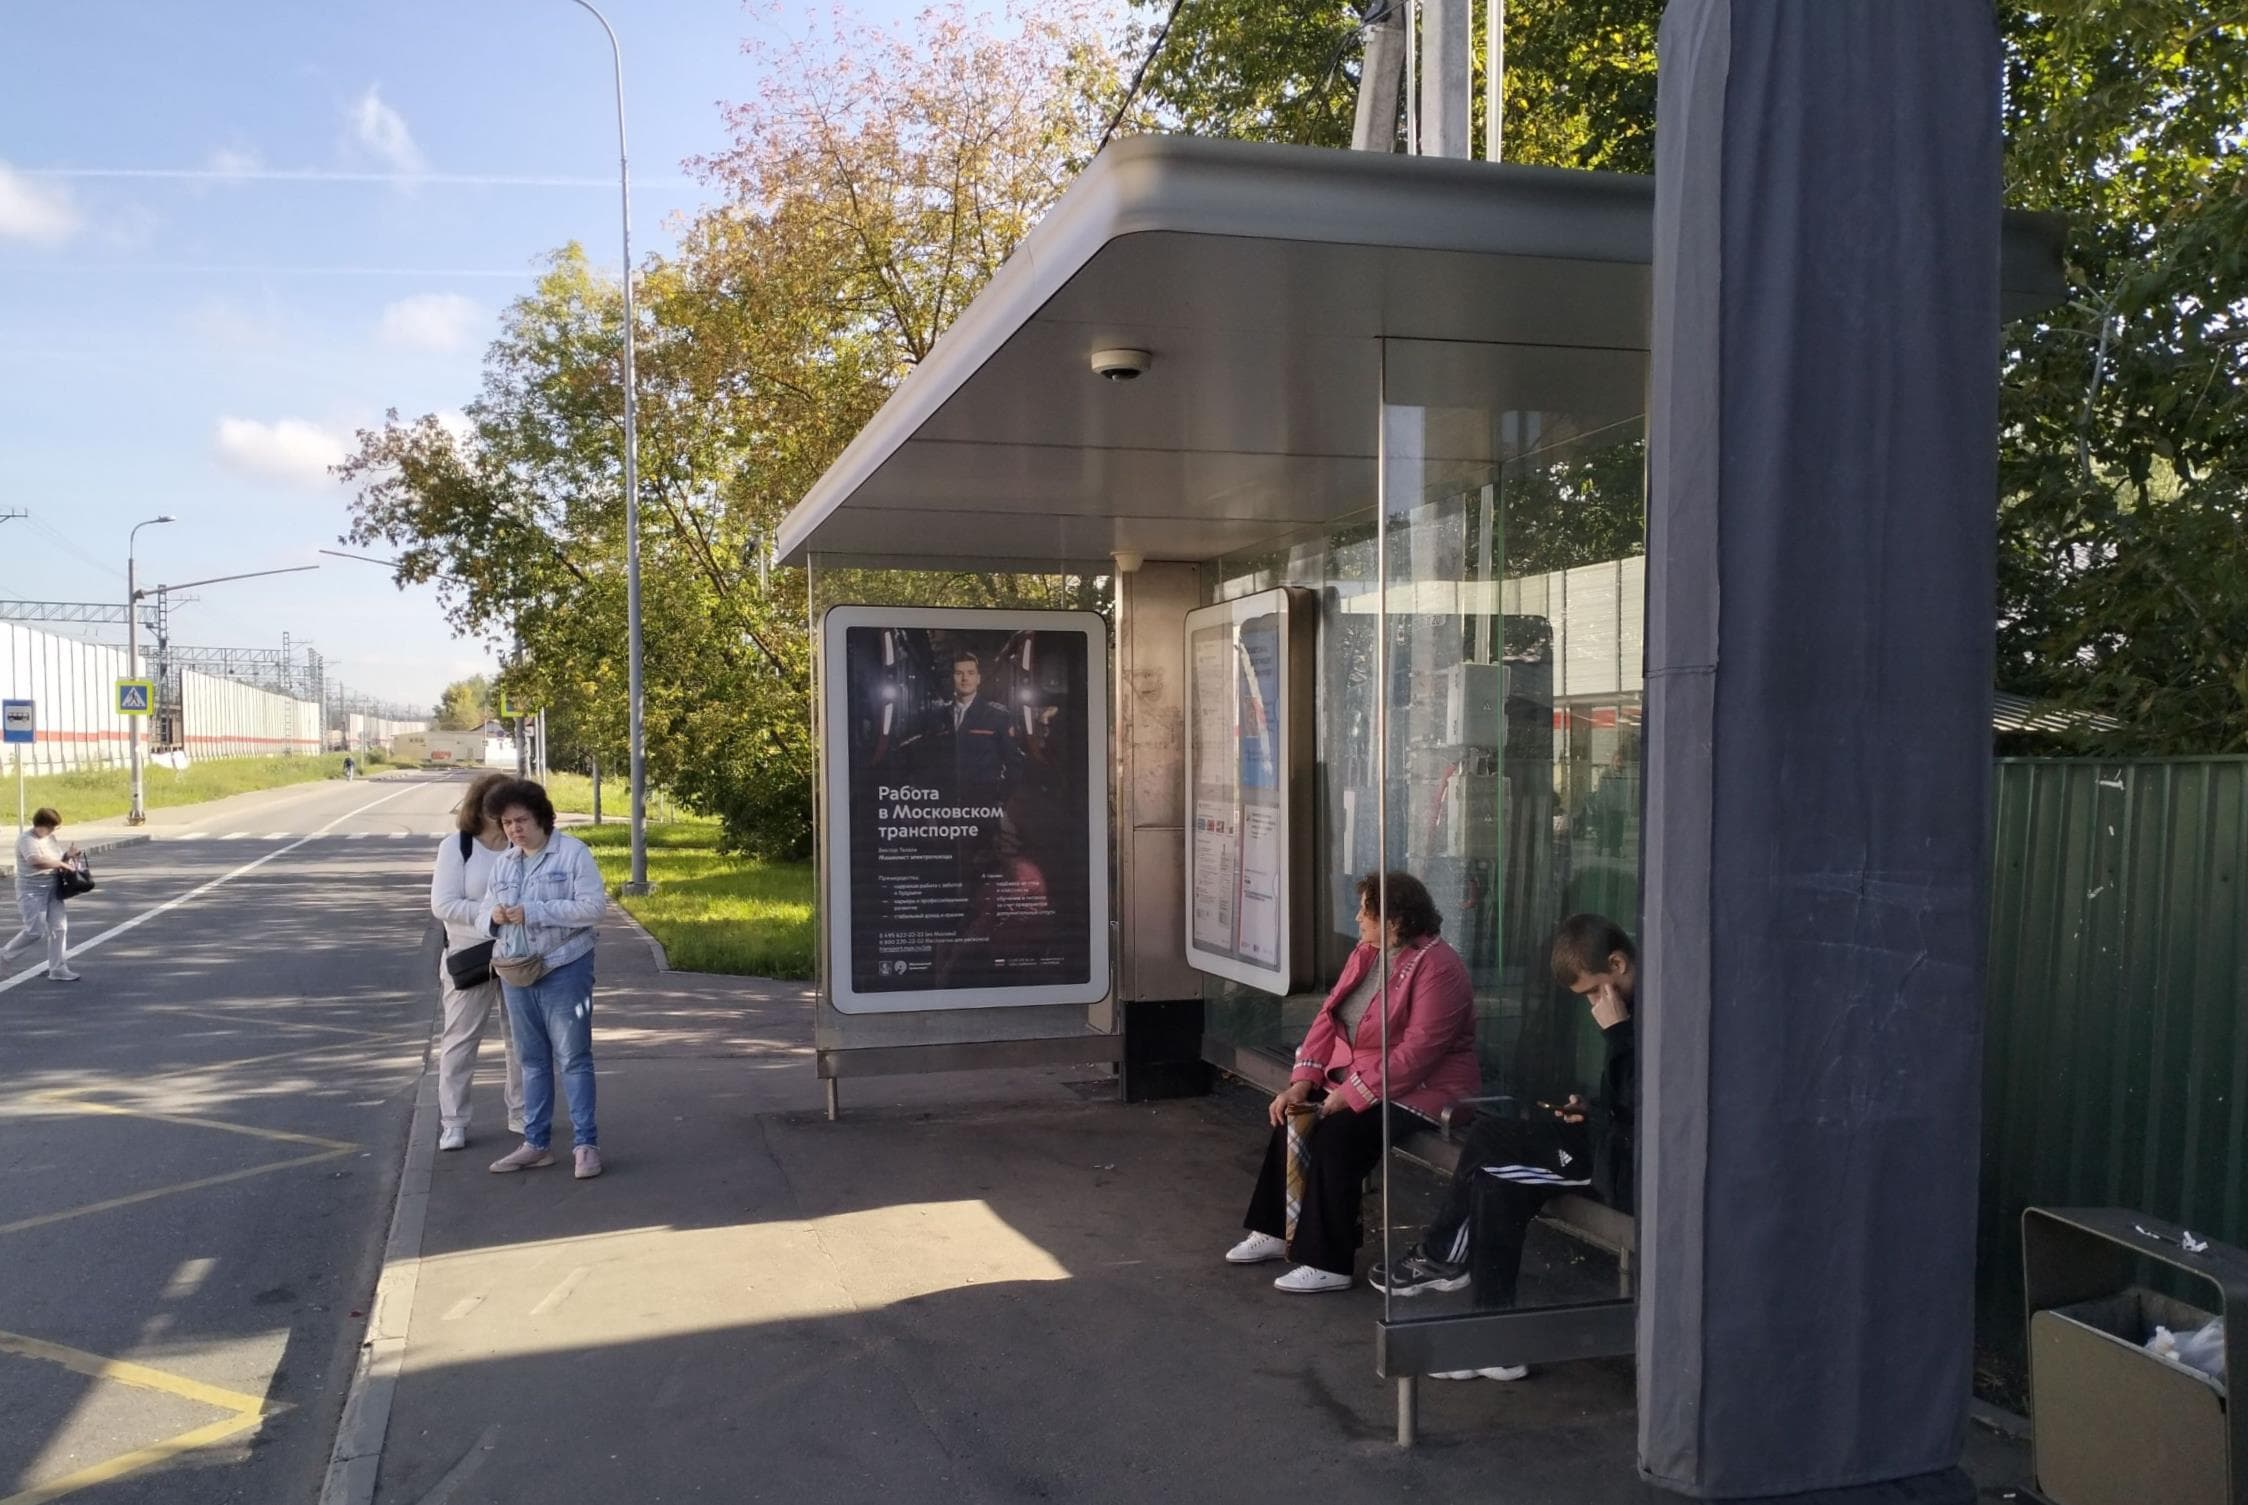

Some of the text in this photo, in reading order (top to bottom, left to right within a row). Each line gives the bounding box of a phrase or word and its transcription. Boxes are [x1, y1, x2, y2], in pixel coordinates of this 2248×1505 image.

[879, 785, 940, 801] Работа
[878, 804, 1004, 820] в Московском
[878, 825, 979, 841] транспорте
